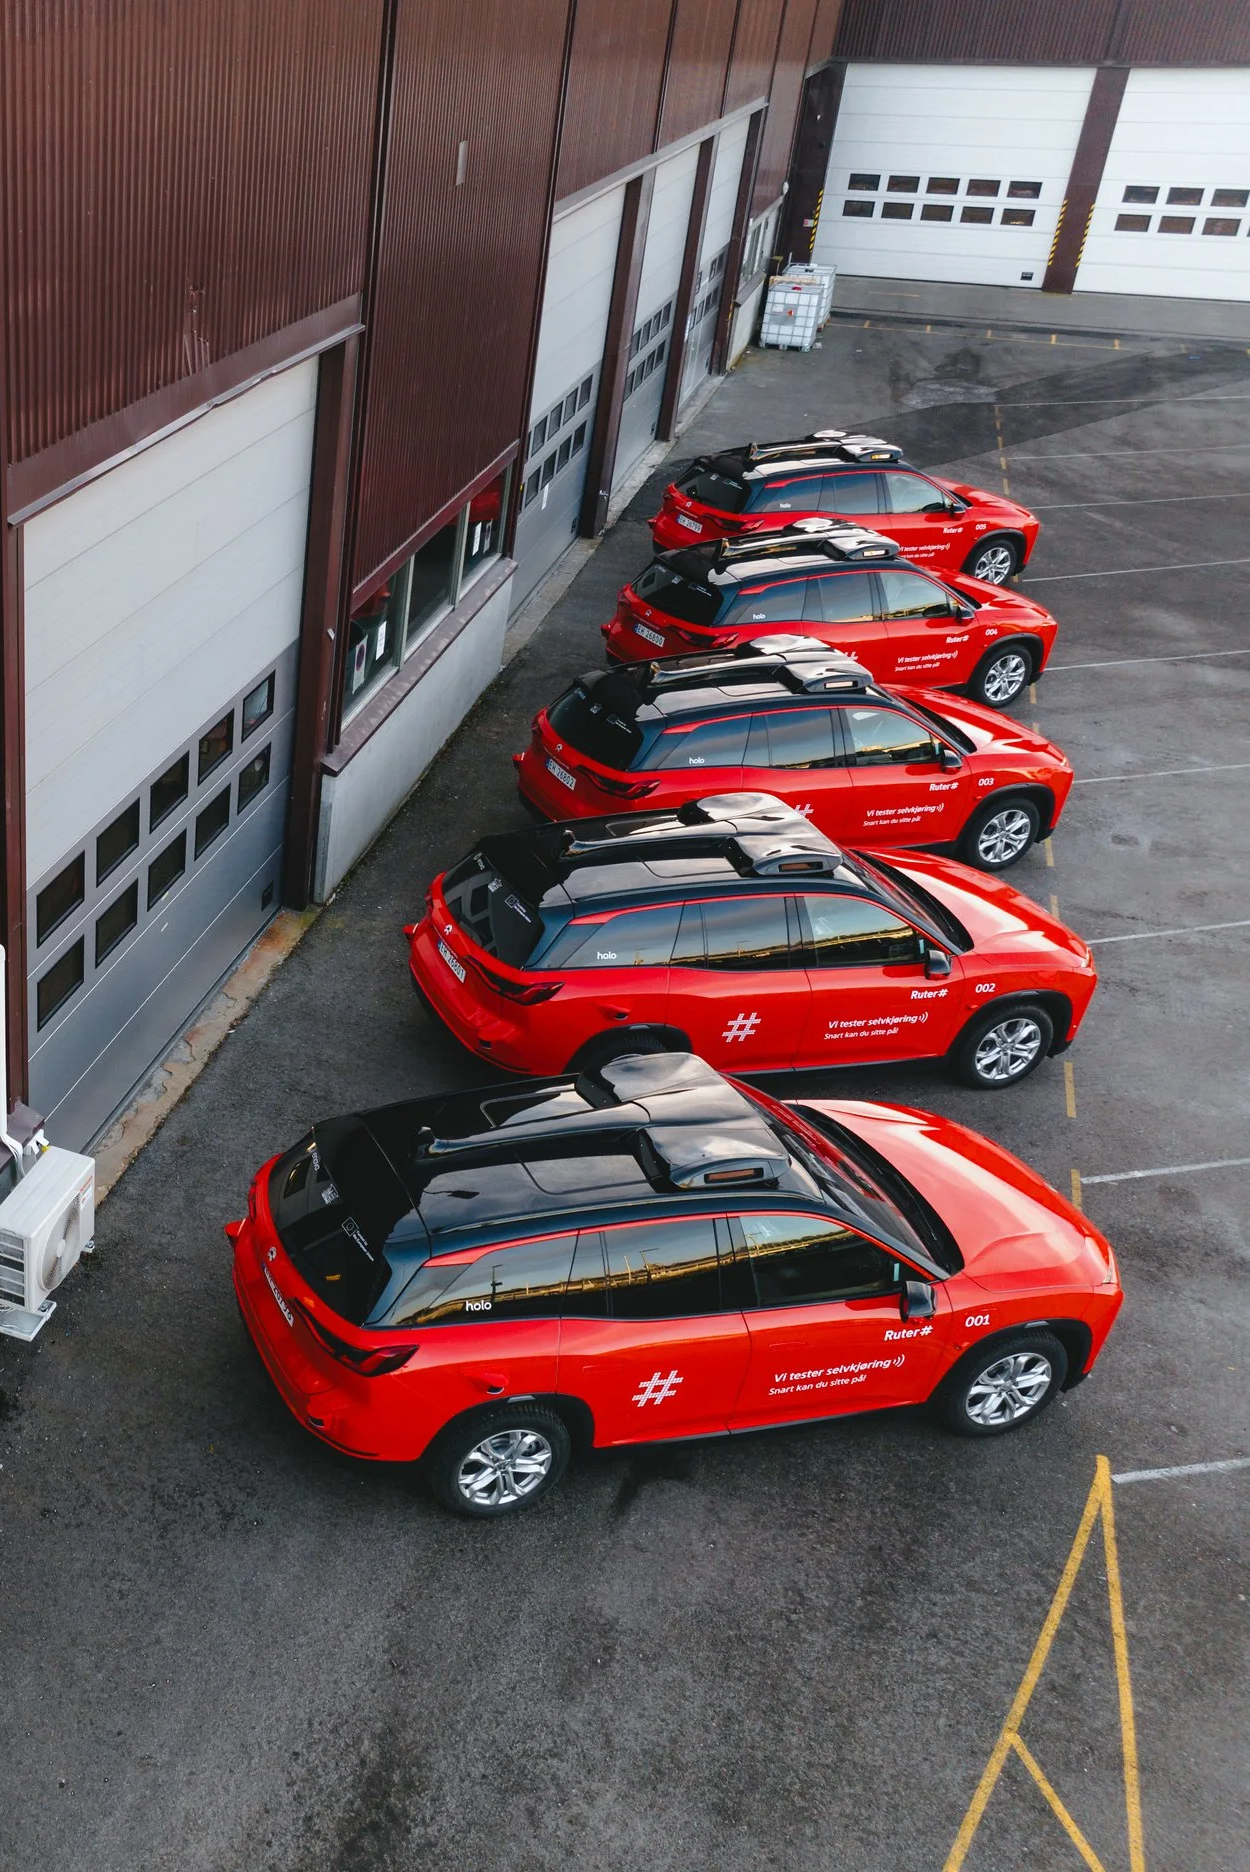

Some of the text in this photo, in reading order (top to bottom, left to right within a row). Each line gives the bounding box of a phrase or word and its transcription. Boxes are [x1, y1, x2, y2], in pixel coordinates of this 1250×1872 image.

[975, 523, 987, 531] 005
[645, 629, 663, 646] 26800
[985, 628, 998, 636] 004
[921, 653, 951, 661] selvkjøring
[689, 756, 705, 764] holo
[556, 768, 575, 788] 26802
[978, 777, 994, 787] 003
[897, 805, 937, 815] selvkjøring
[597, 951, 617, 960] holo
[910, 988, 949, 1000] Ruter#
[975, 983, 996, 993] 002
[828, 1014, 918, 1029] Vi tester selvkjøring
[824, 1026, 899, 1040] Snart kan du sitte på!
[465, 1300, 492, 1312] holo
[964, 1314, 991, 1328] 001
[883, 1325, 934, 1342] Ruter#
[774, 1358, 892, 1383] Vi tester selvkjøring
[768, 1374, 867, 1396] Snart kan du sitte på!
